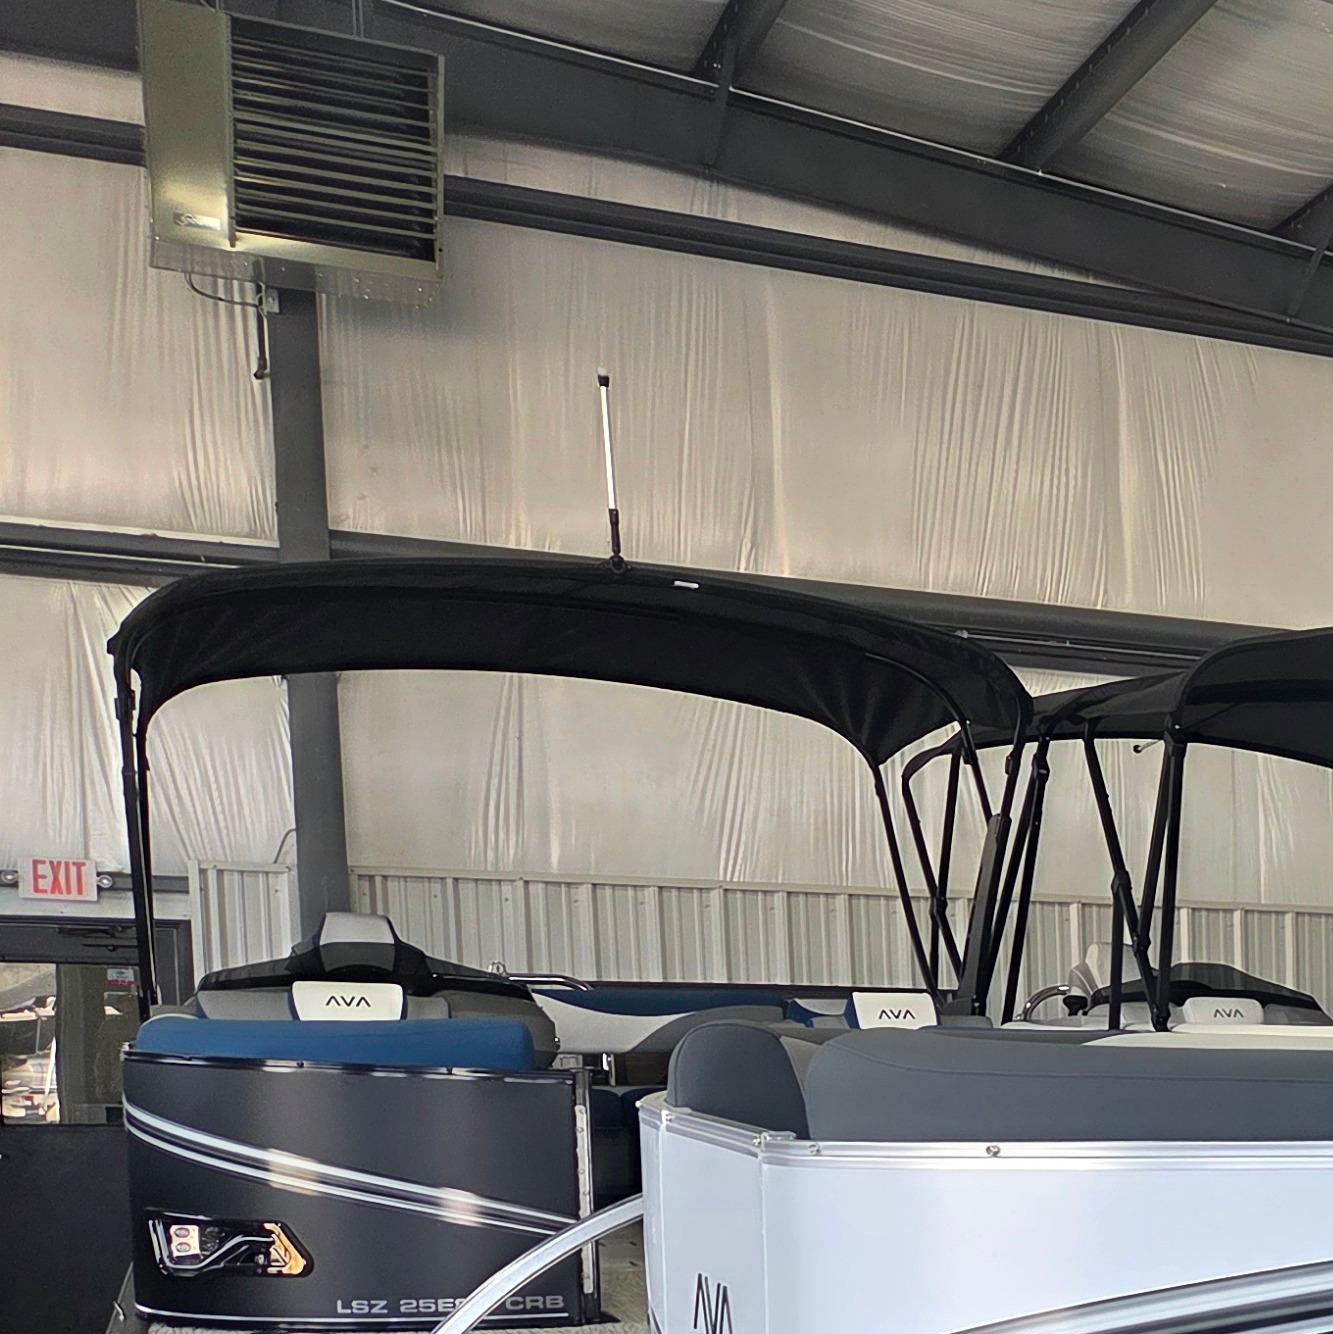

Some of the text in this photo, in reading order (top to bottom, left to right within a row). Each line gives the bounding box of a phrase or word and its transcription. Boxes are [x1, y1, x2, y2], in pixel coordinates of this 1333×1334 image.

[31, 859, 87, 896] EXIT
[325, 995, 371, 1008] AVA
[878, 1008, 916, 1020] AVA
[336, 1299, 389, 1315] LSZ
[505, 1294, 565, 1311] CRB
